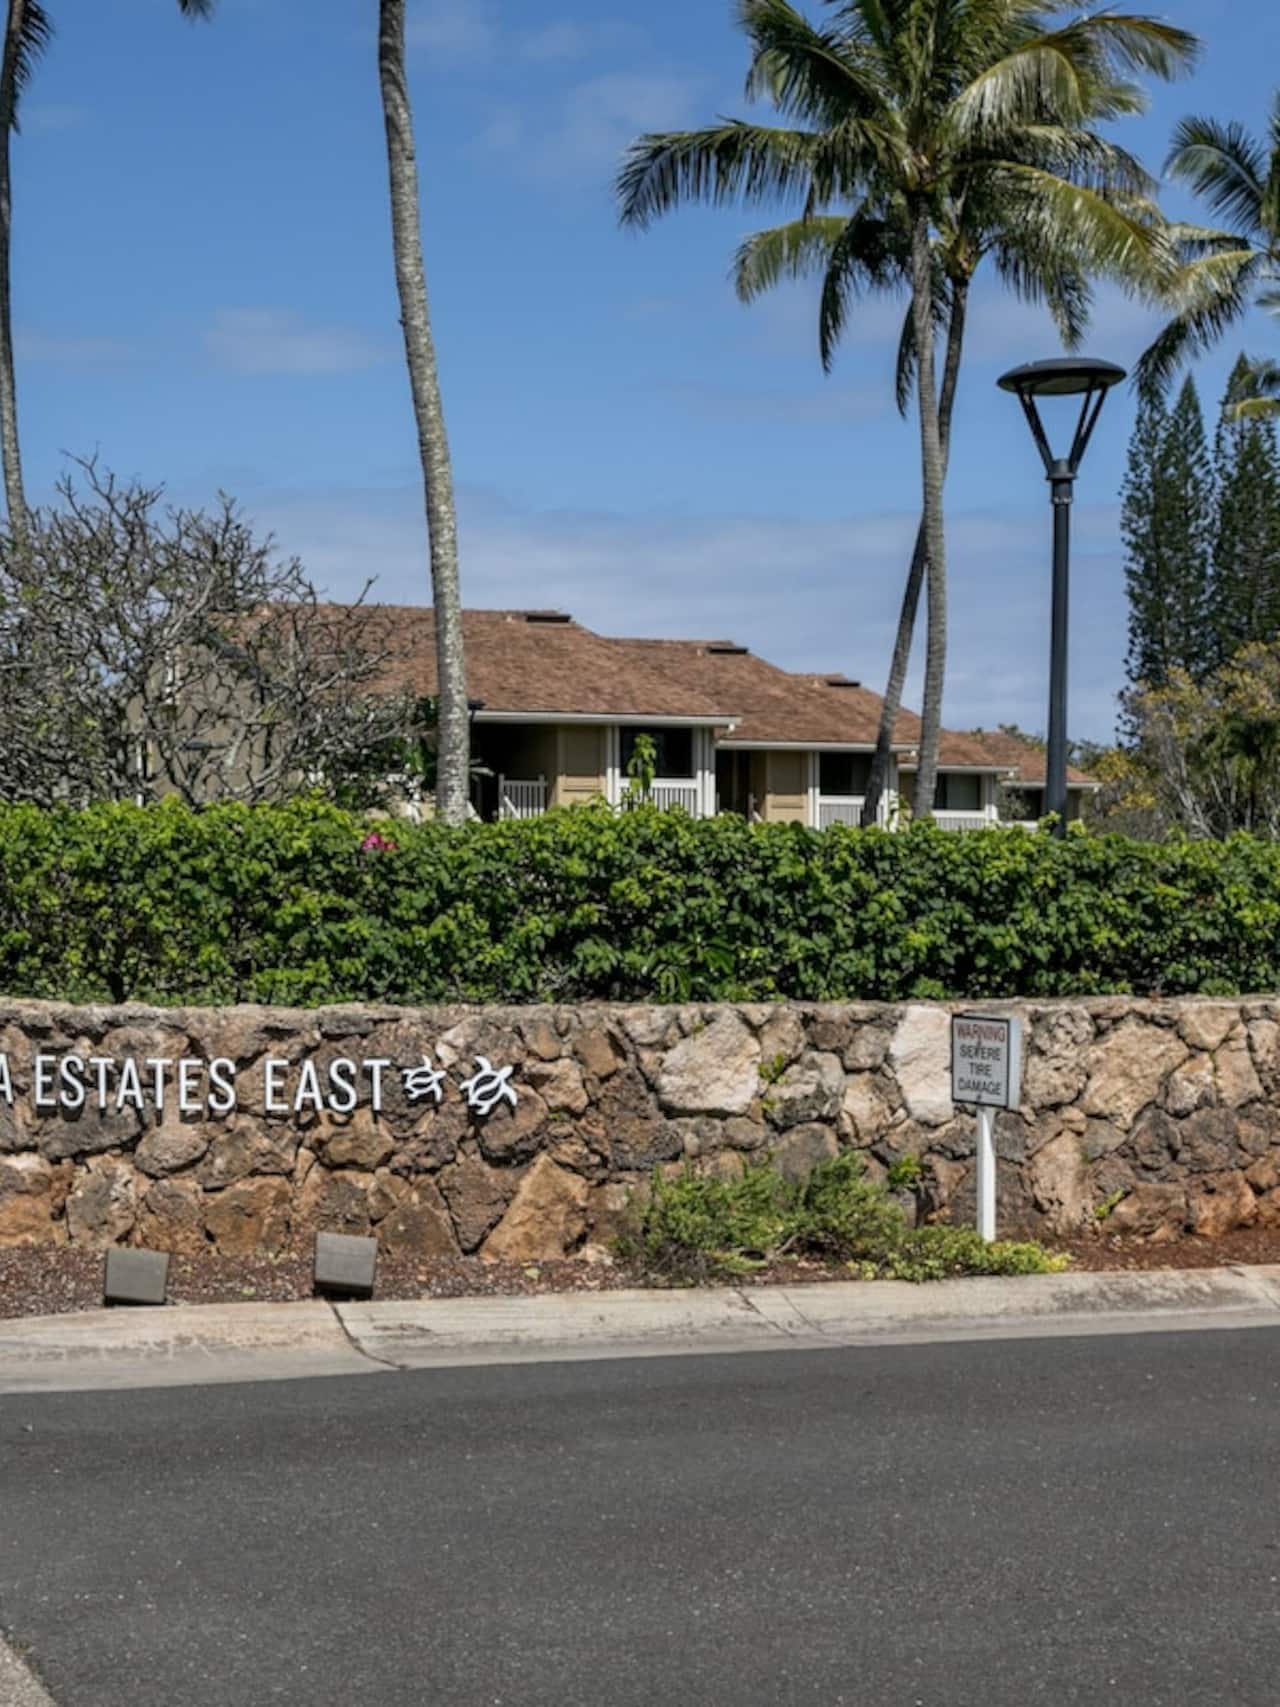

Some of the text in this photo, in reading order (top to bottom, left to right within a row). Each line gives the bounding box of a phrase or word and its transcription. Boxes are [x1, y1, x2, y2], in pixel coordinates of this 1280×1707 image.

[956, 1023, 1005, 1042] WARNING
[959, 1044, 1001, 1061] SEVERE
[969, 1062, 993, 1077] TIRE
[35, 1055, 236, 1111] ESTATES
[265, 1058, 391, 1112] EAST
[958, 1077, 1001, 1096] DAMAGE
